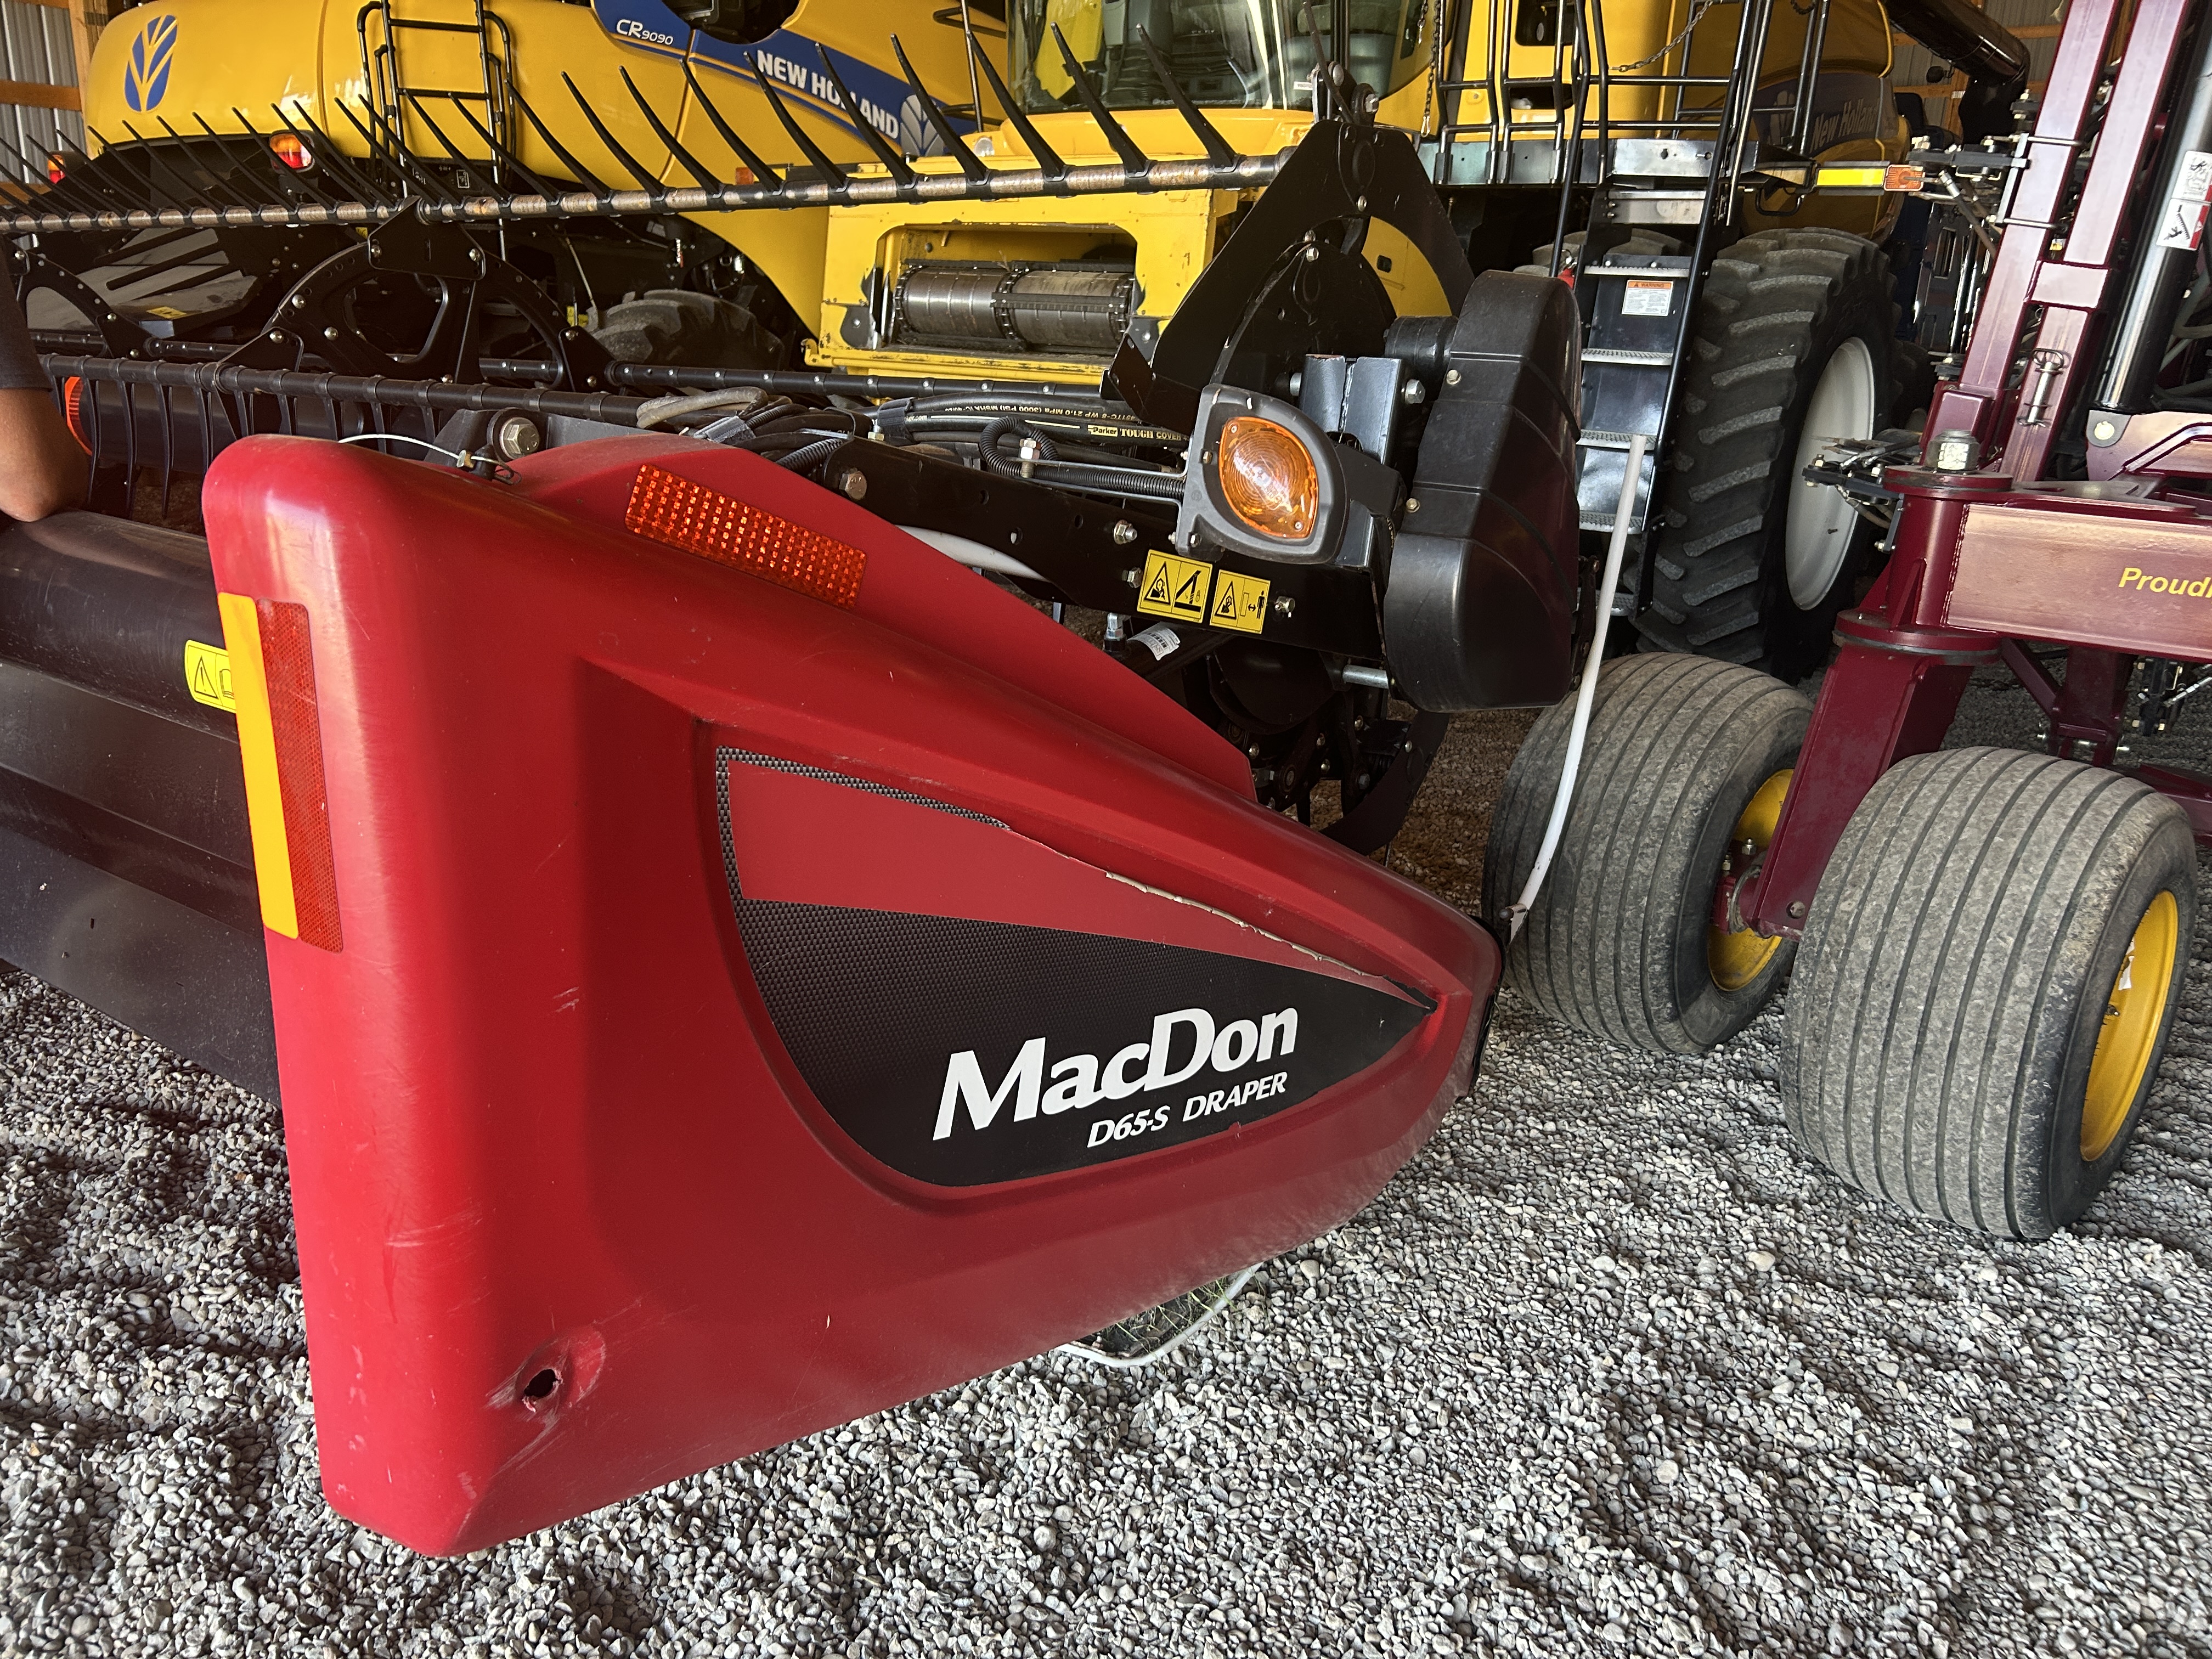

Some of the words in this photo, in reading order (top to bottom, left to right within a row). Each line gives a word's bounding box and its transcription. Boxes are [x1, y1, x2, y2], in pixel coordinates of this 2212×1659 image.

[616, 19, 674, 45] CR9090
[757, 49, 808, 89] NEW
[811, 72, 899, 139] HOAND
[1809, 113, 1840, 154] New
[1093, 426, 1118, 436] Parker
[1119, 428, 1154, 439] TOUGH
[932, 1006, 1298, 1141] MacDon
[1087, 1105, 1170, 1148] D65-S
[1182, 1071, 1288, 1122] DRAPER
